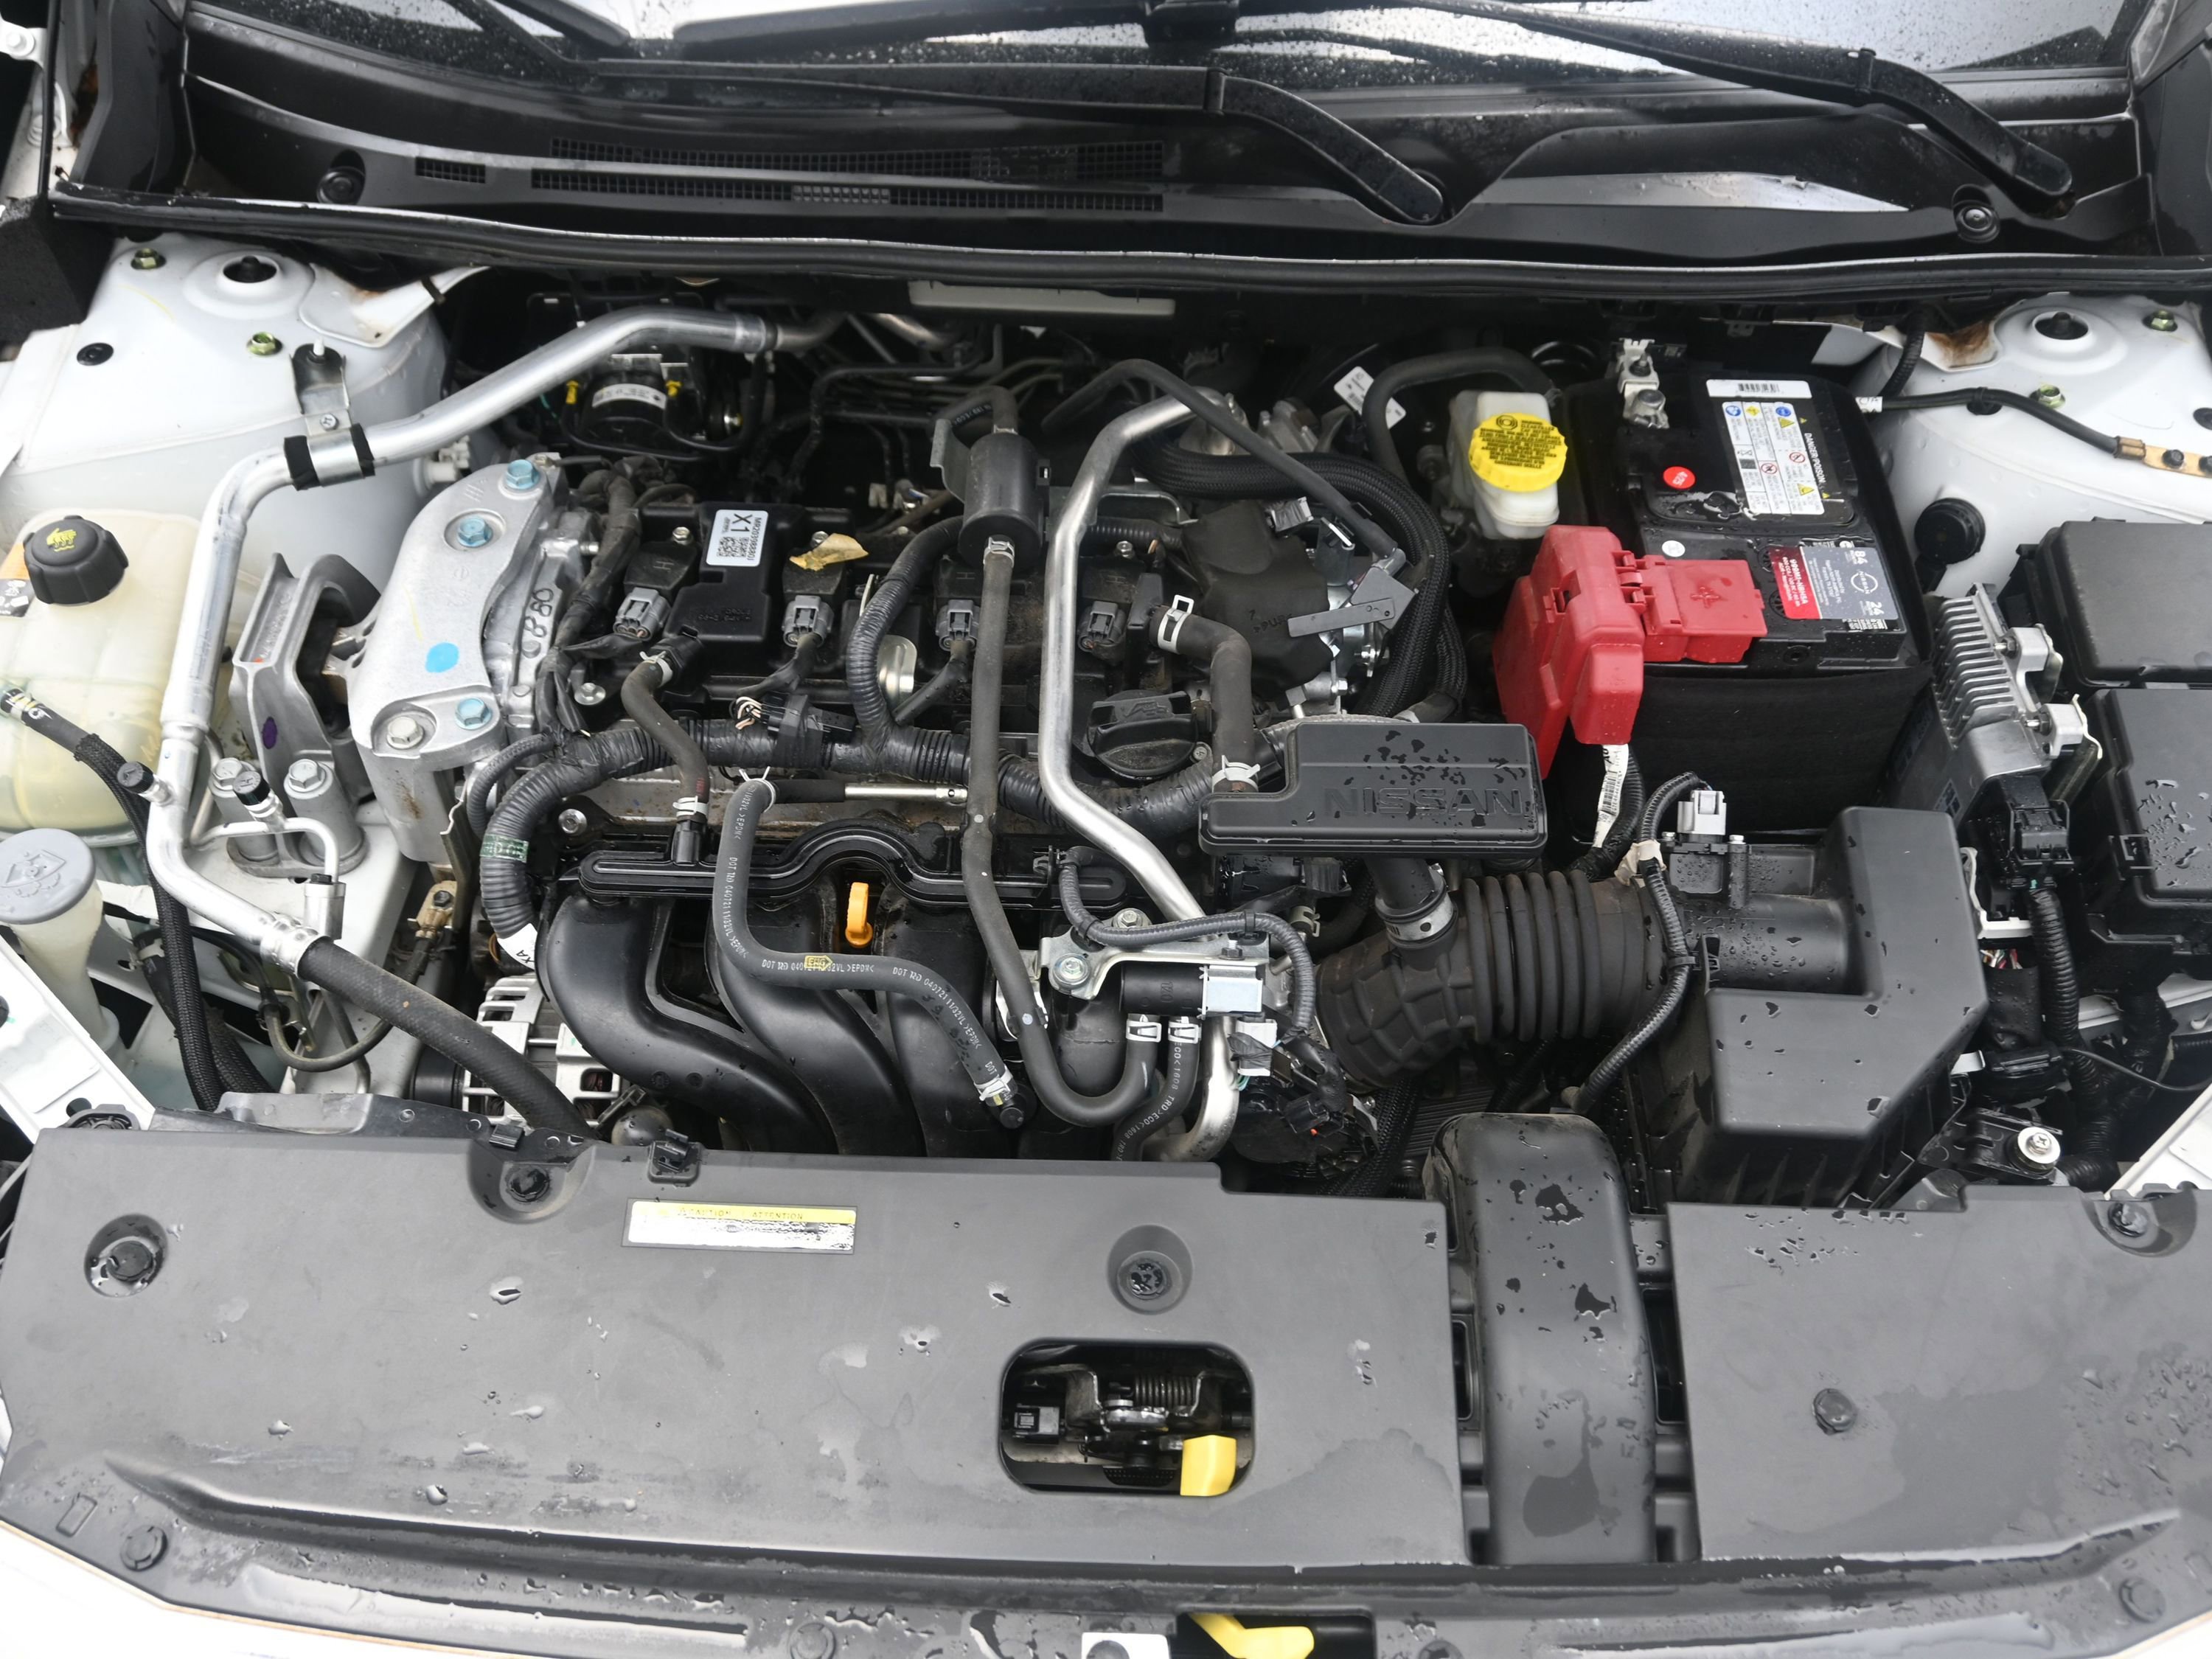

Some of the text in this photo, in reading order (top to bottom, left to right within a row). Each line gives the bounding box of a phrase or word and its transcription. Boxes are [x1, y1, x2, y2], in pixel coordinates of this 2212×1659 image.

[731, 514, 753, 532] X1
[1857, 550, 1868, 563] 84
[1859, 571, 1871, 594] NISSAN
[1873, 602, 1884, 614] 24
[1323, 787, 1523, 815] NISSAN
[728, 857, 738, 869] DOT
[723, 886, 734, 908] 040721
[762, 959, 775, 969] DOT
[892, 967, 907, 977] DOT
[924, 978, 947, 1001] 040721
